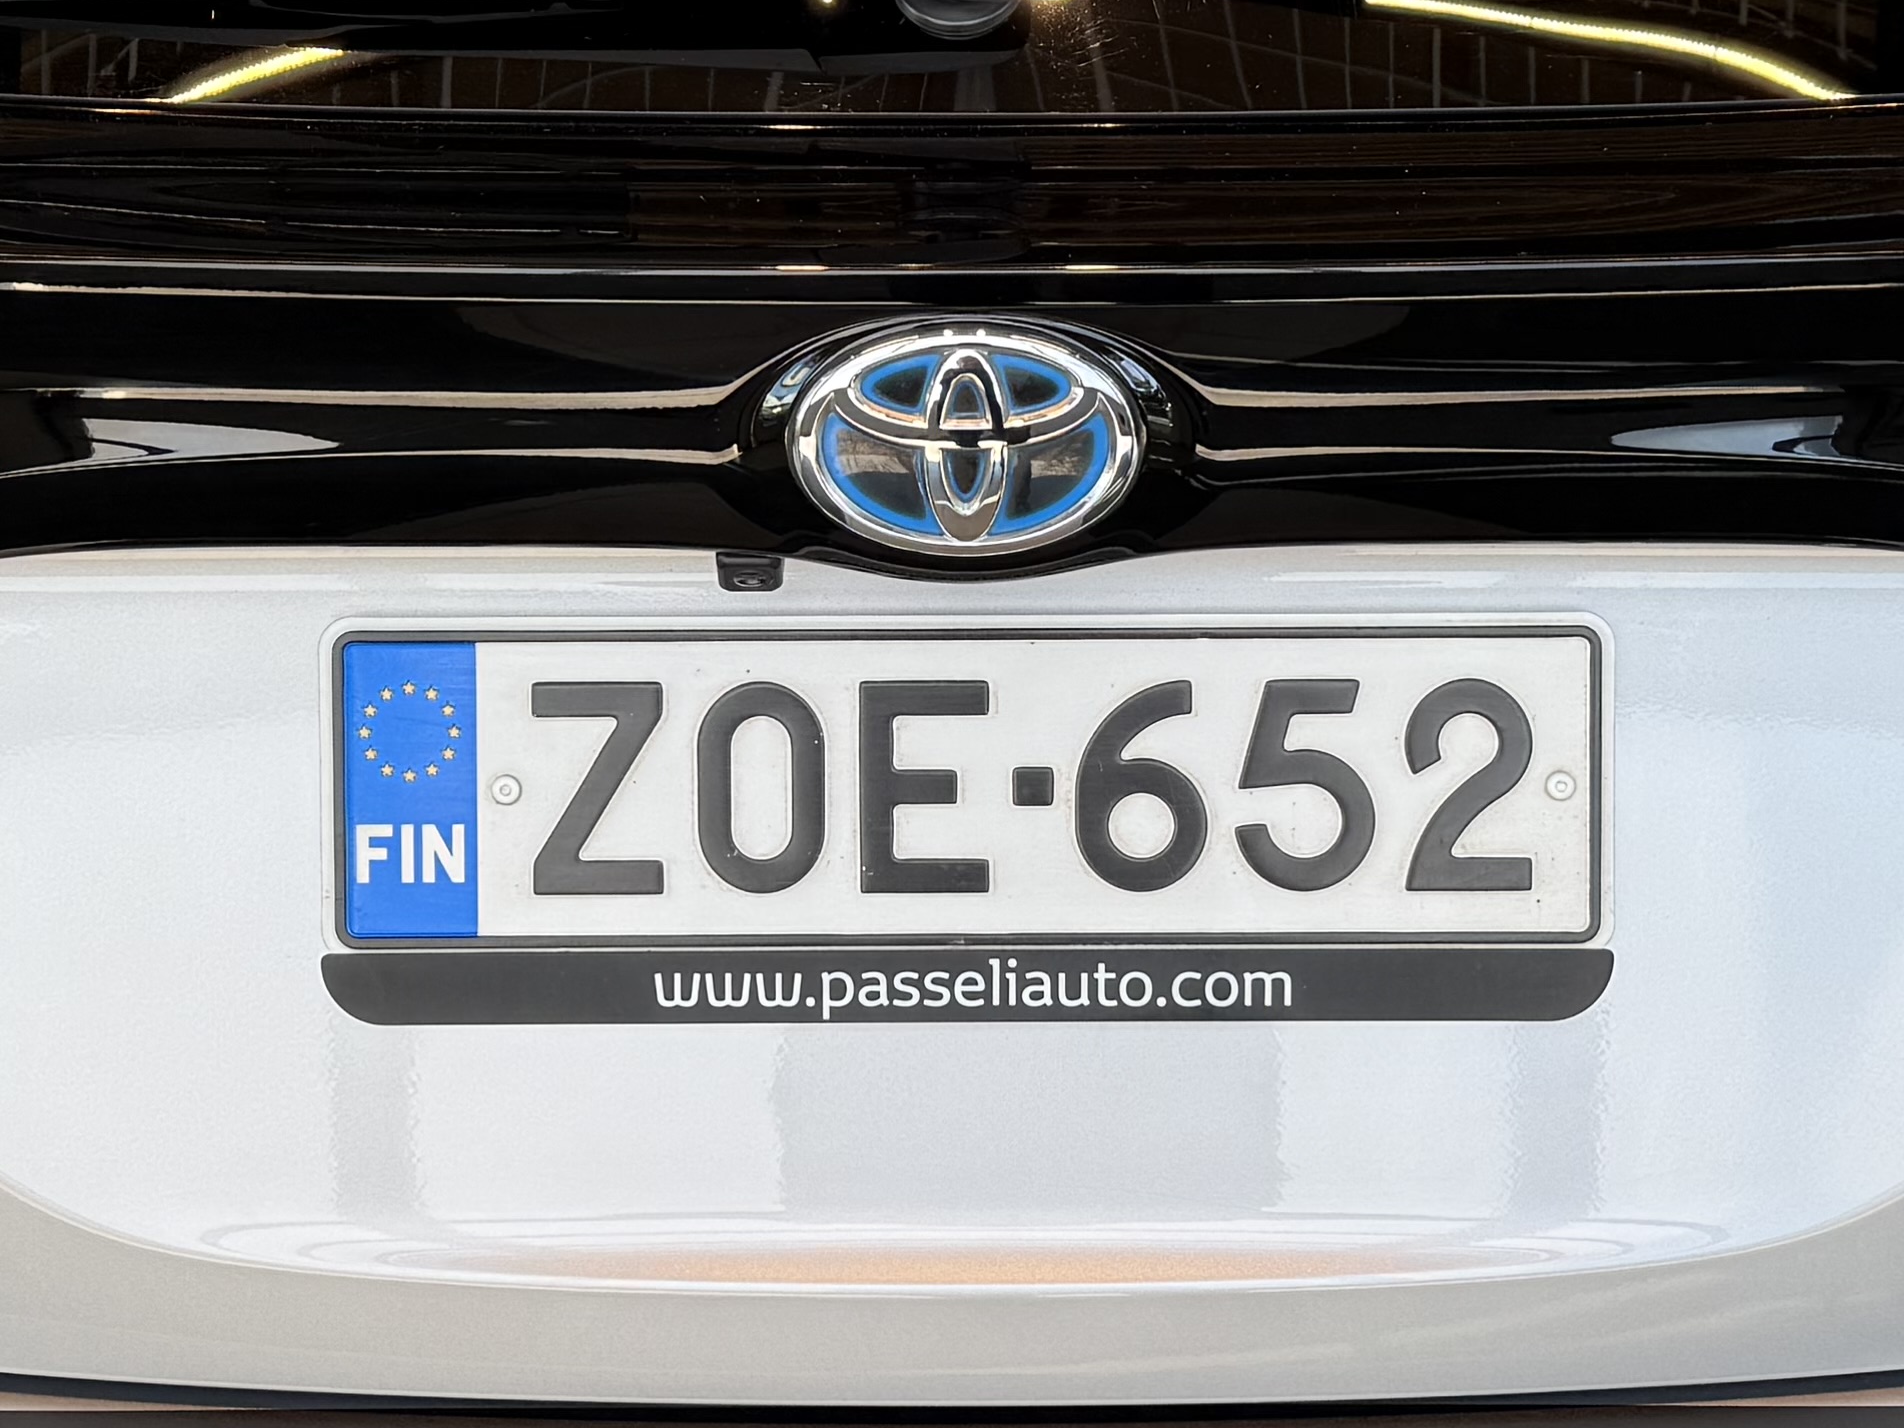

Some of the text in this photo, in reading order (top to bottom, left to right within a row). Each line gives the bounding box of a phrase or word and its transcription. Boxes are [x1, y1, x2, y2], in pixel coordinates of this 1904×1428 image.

[530, 676, 1536, 896] ZOE-652
[354, 822, 467, 885] FIN
[653, 958, 1293, 1019] www.passeliauto.com
